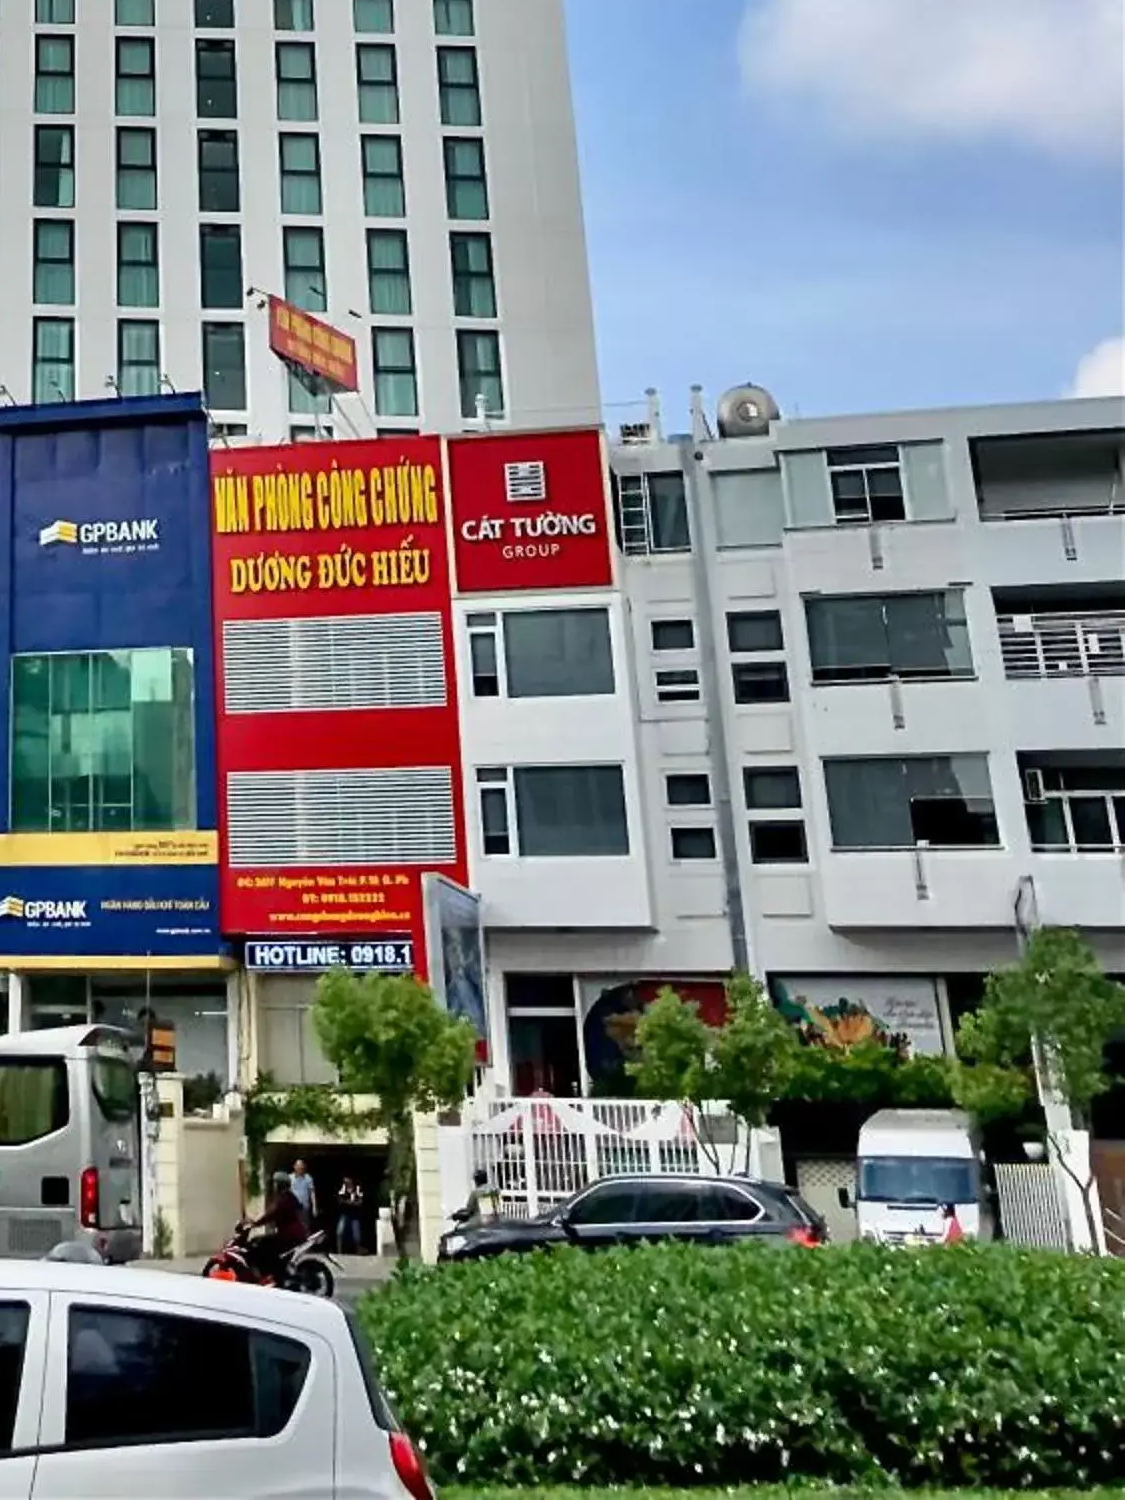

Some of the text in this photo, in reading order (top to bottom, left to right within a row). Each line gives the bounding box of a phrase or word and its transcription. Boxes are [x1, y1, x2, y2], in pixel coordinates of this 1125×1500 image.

[214, 454, 438, 533] VĂN PHÒNG CÔNG CHỨNG
[80, 519, 158, 543] GPBANK
[461, 510, 596, 541] CÁT TƯỜNG
[502, 543, 560, 559] GROUP
[230, 534, 430, 593] DƯƠNG ĐỨC HIẾU
[24, 900, 88, 920] GPBANK
[255, 944, 411, 966] HOTLINE: 0918.1
